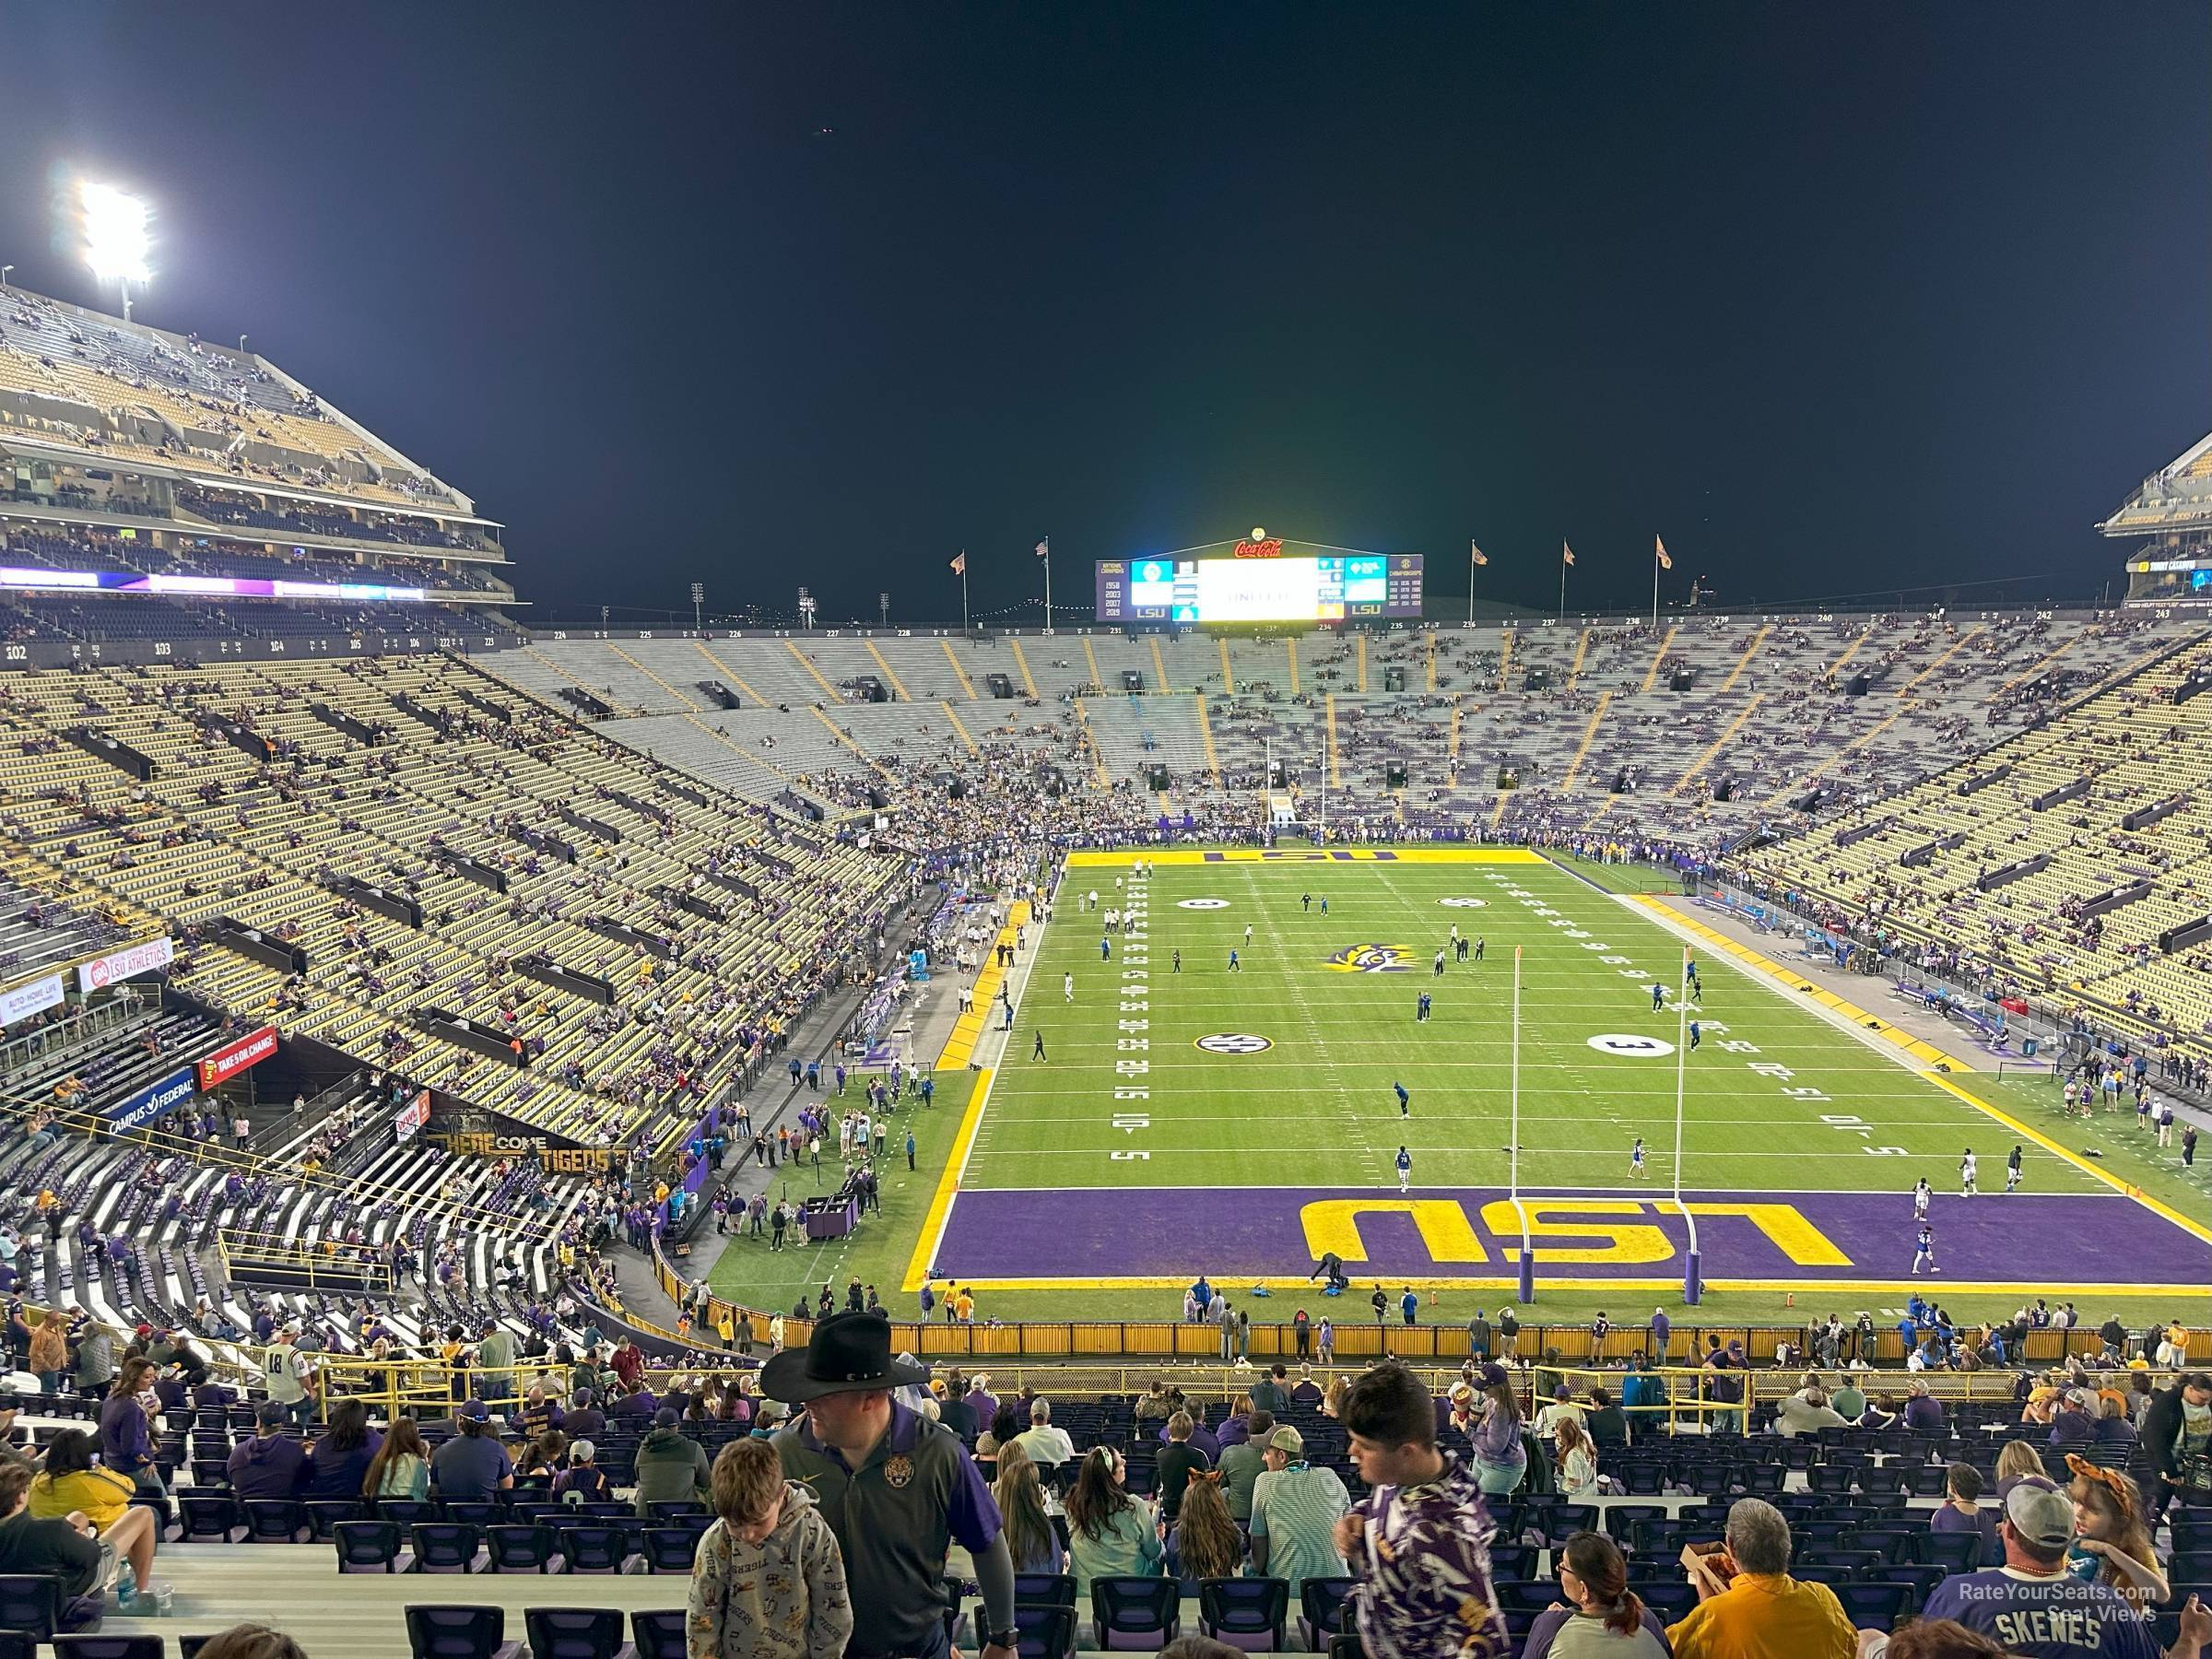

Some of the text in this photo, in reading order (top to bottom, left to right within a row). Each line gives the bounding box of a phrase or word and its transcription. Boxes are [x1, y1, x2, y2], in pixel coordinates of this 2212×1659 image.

[1235, 540, 1282, 558] Coca-Cola
[1106, 599, 1121, 607] 2007
[1106, 608, 1121, 617] 2019
[1136, 608, 1166, 618] LSU
[1351, 605, 1382, 615] LSU
[2037, 611, 2053, 619] 242
[2156, 609, 2171, 618] 243
[1818, 614, 1833, 622] 240
[554, 630, 567, 640] 224
[639, 630, 653, 639] 225
[728, 629, 742, 638] 226
[826, 629, 840, 638] 227
[350, 639, 362, 650] 105
[409, 638, 420, 648] 106
[440, 637, 451, 647] 222
[485, 637, 495, 646] 223
[155, 642, 171, 655] 103
[270, 641, 285, 653] 104
[6, 645, 28, 660] 102
[1203, 851, 1399, 863] LSU
[110, 947, 167, 978] LSU ATHLETICS
[9, 996, 25, 1008] AUTO
[28, 988, 44, 1002] HOME
[46, 983, 57, 994] LIFE
[218, 1035, 274, 1073] TAKE 5 OIL CHANGE
[109, 1079, 194, 1135] CAMPUS FEDERAL
[1299, 1199, 1855, 1266] LSU
[2038, 1314, 2045, 1324] 9
[269, 1352, 283, 1374] 18
[1994, 1610, 2102, 1650] SKENES
